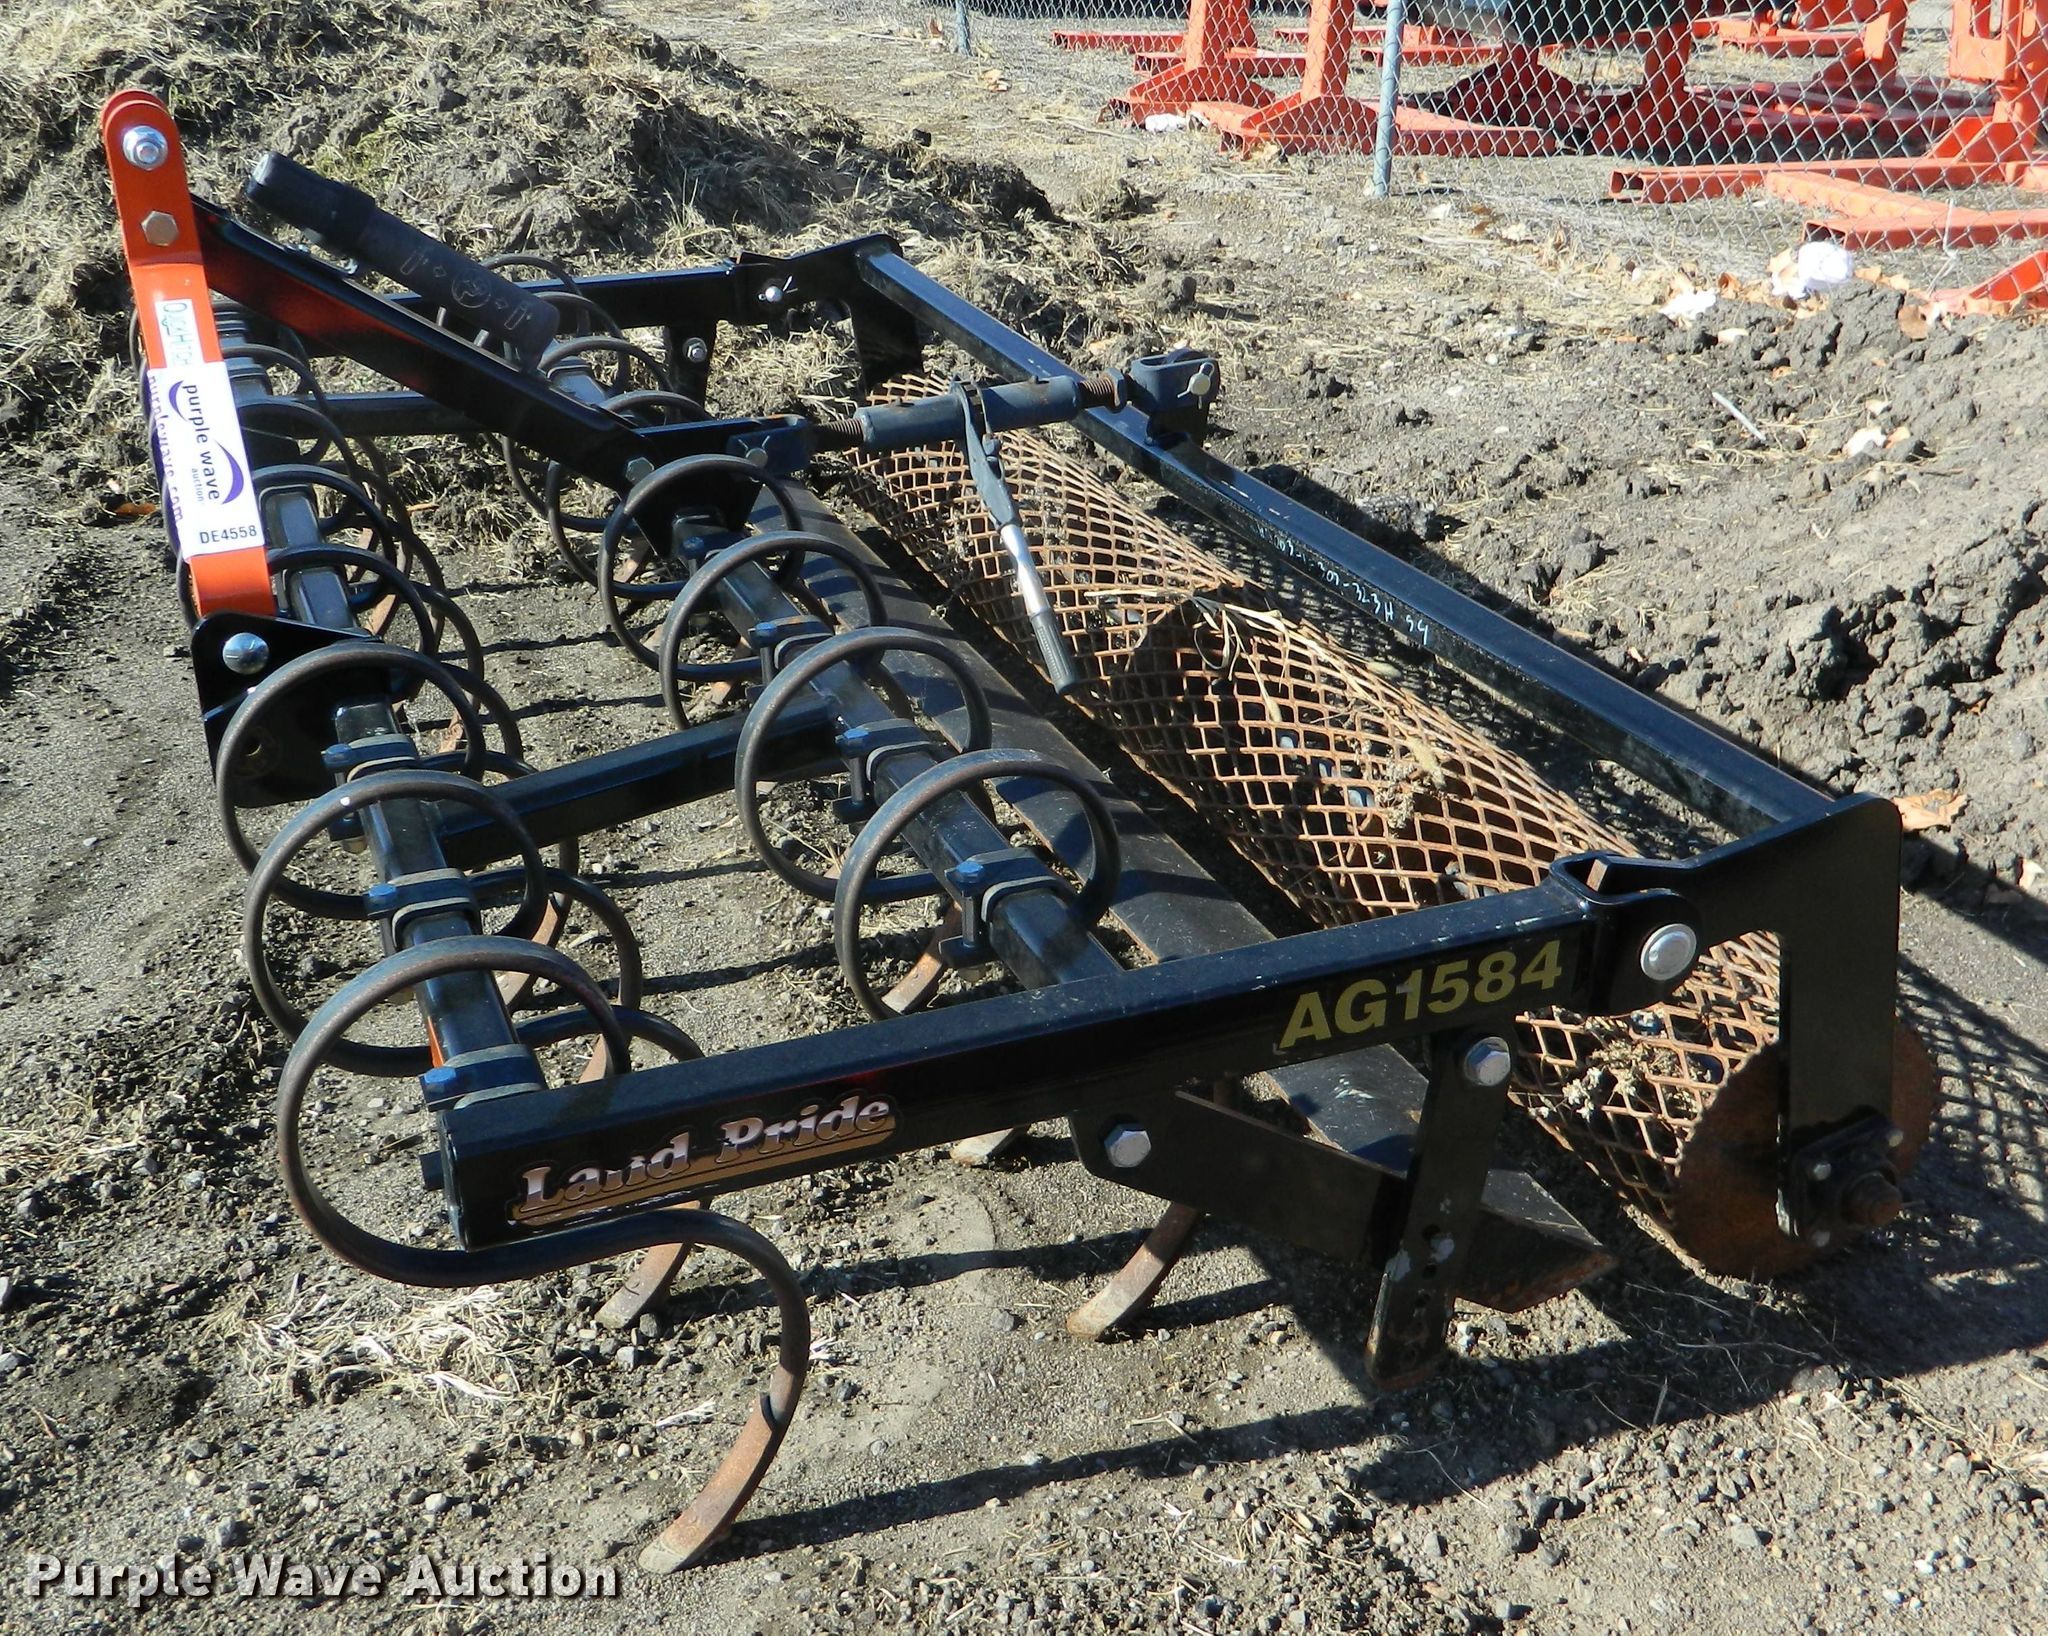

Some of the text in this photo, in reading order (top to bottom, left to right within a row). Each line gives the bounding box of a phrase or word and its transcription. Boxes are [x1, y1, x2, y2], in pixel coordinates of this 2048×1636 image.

[147, 374, 185, 523] purplewavecom
[183, 384, 221, 501] purple wave
[191, 467, 205, 502] auction
[199, 524, 258, 544] DE4558
[1278, 939, 1563, 1050] AG1584
[518, 1094, 893, 1214] Land Pride
